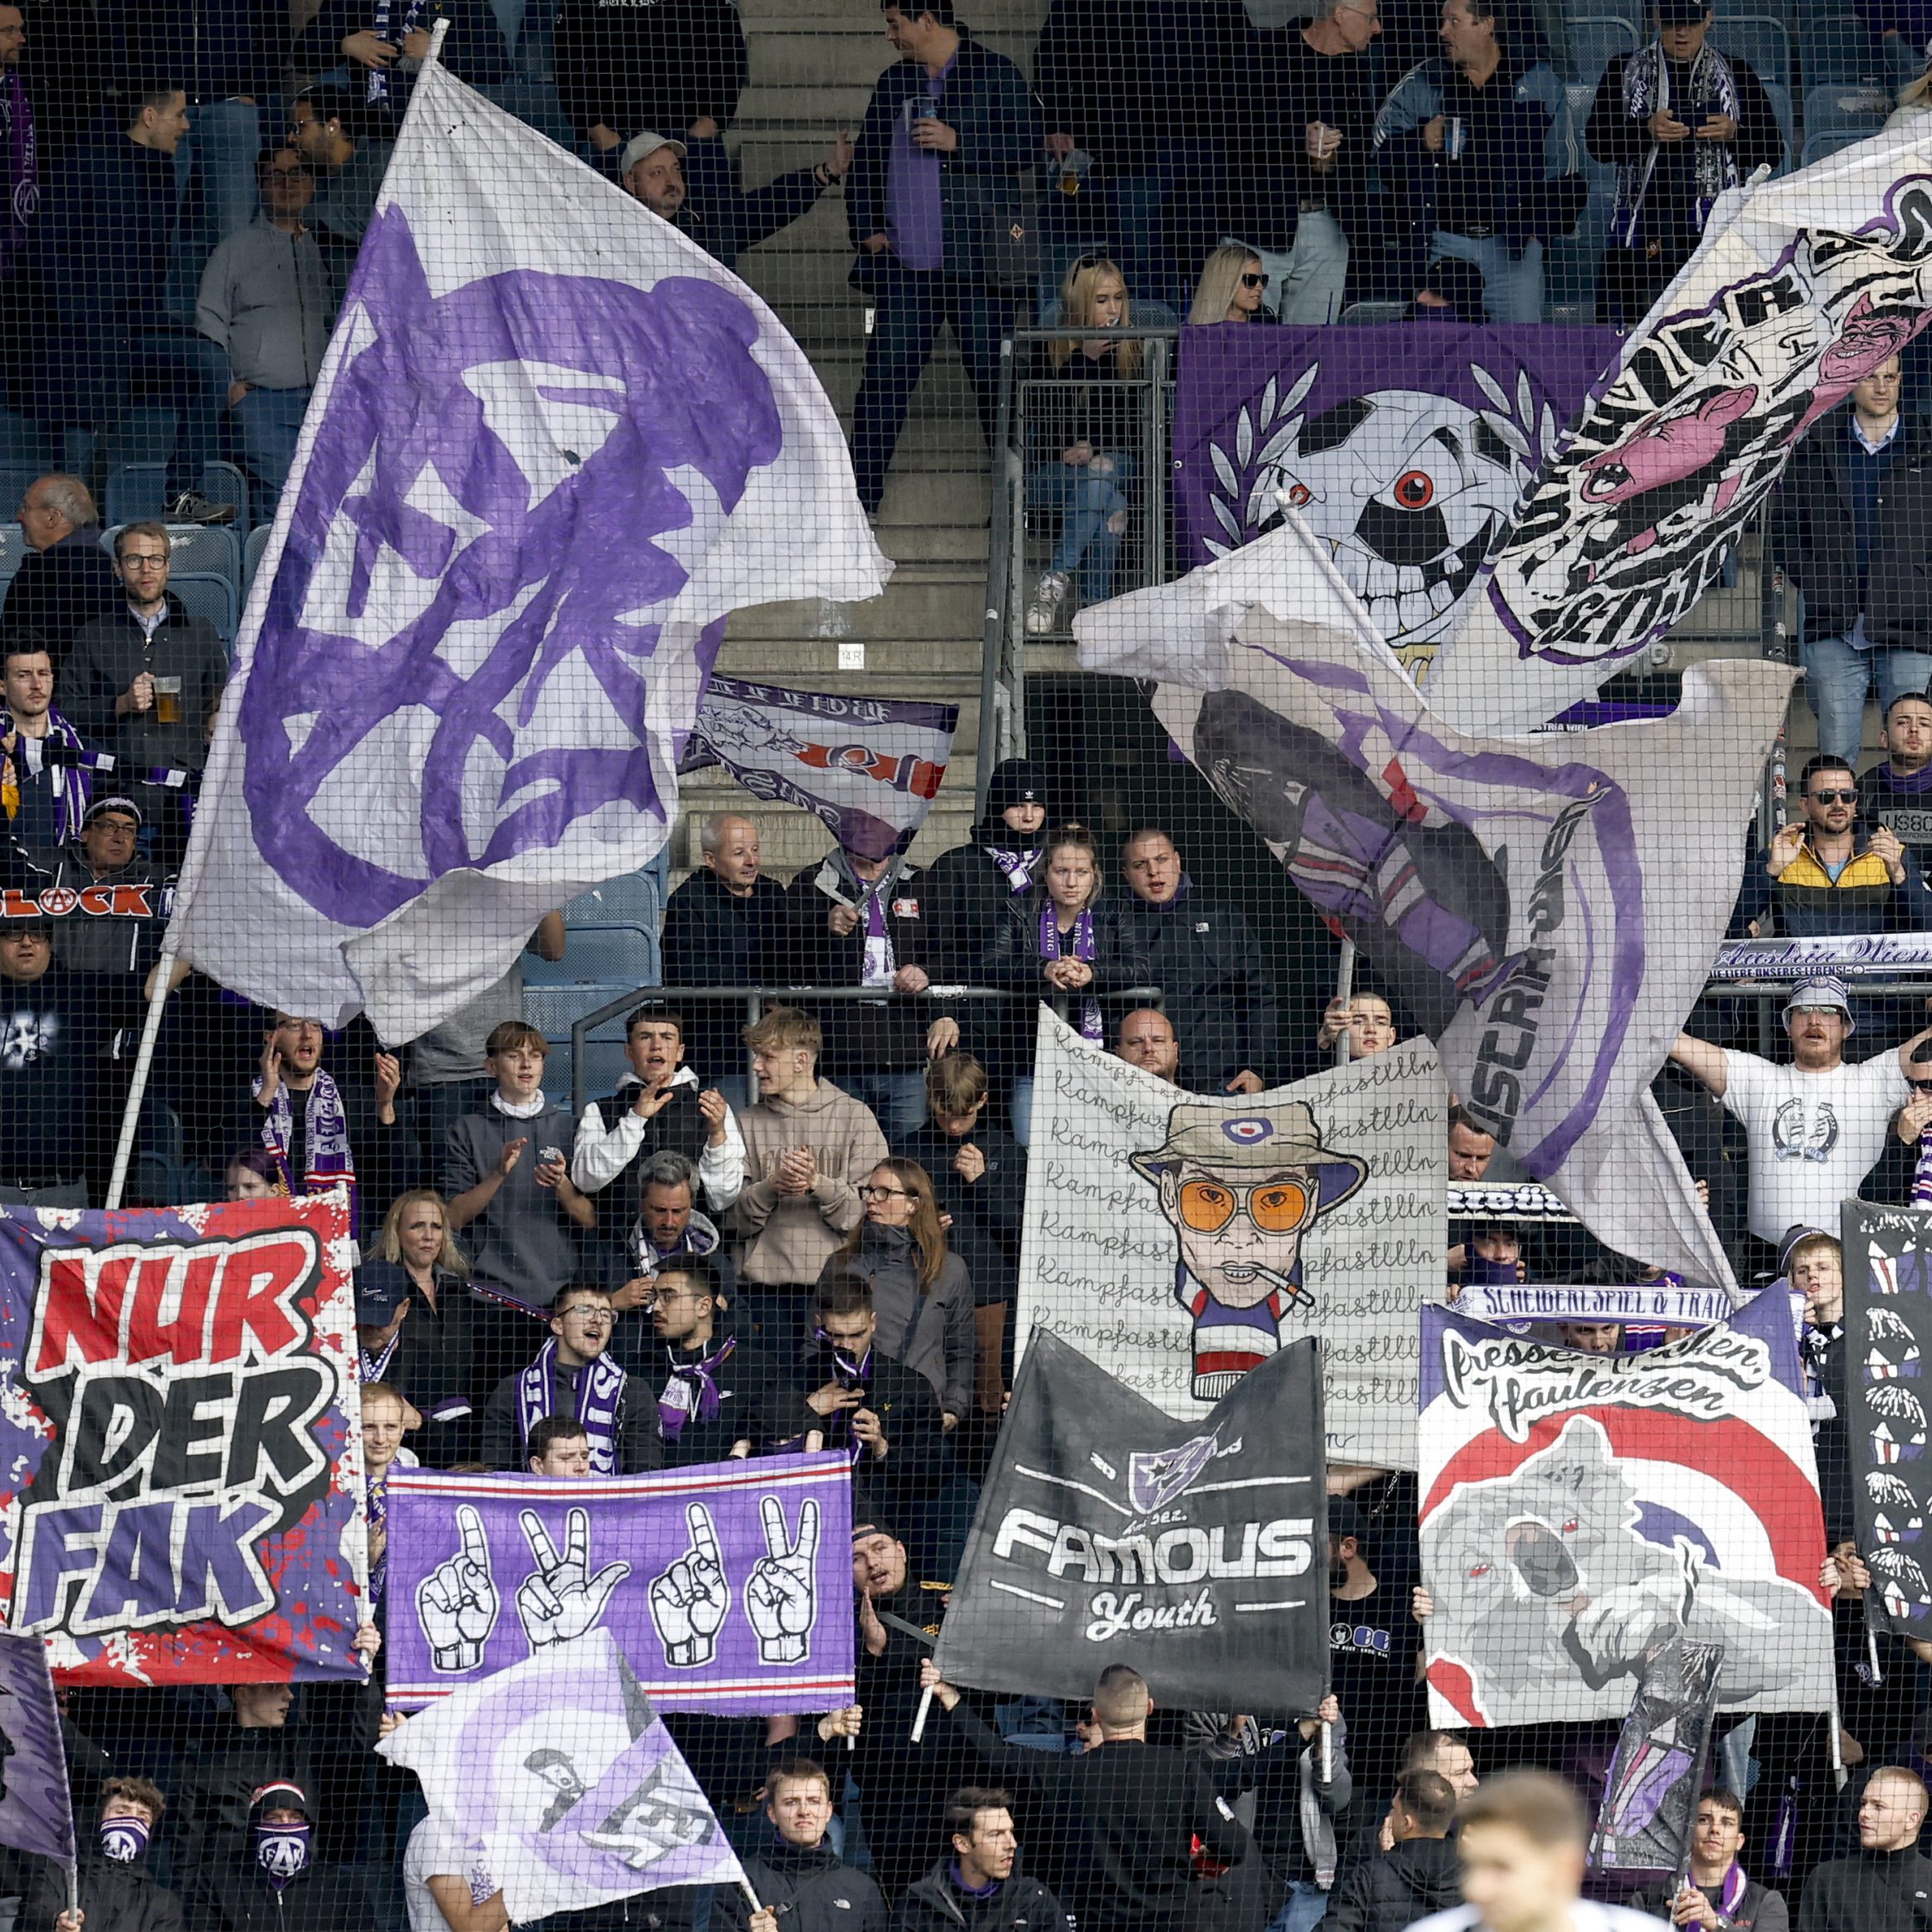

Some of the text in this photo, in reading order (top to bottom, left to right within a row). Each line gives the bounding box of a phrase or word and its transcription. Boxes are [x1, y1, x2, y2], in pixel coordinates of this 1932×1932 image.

[1046, 921, 1054, 951] EWIG
[1302, 1239, 1438, 1282] pfastllln
[33, 1239, 311, 1375] NUR
[68, 1365, 324, 1491] DER
[22, 1501, 274, 1629] FAK
[992, 1507, 1315, 1585] FAMOUS
[1085, 1586, 1218, 1643] Youth
